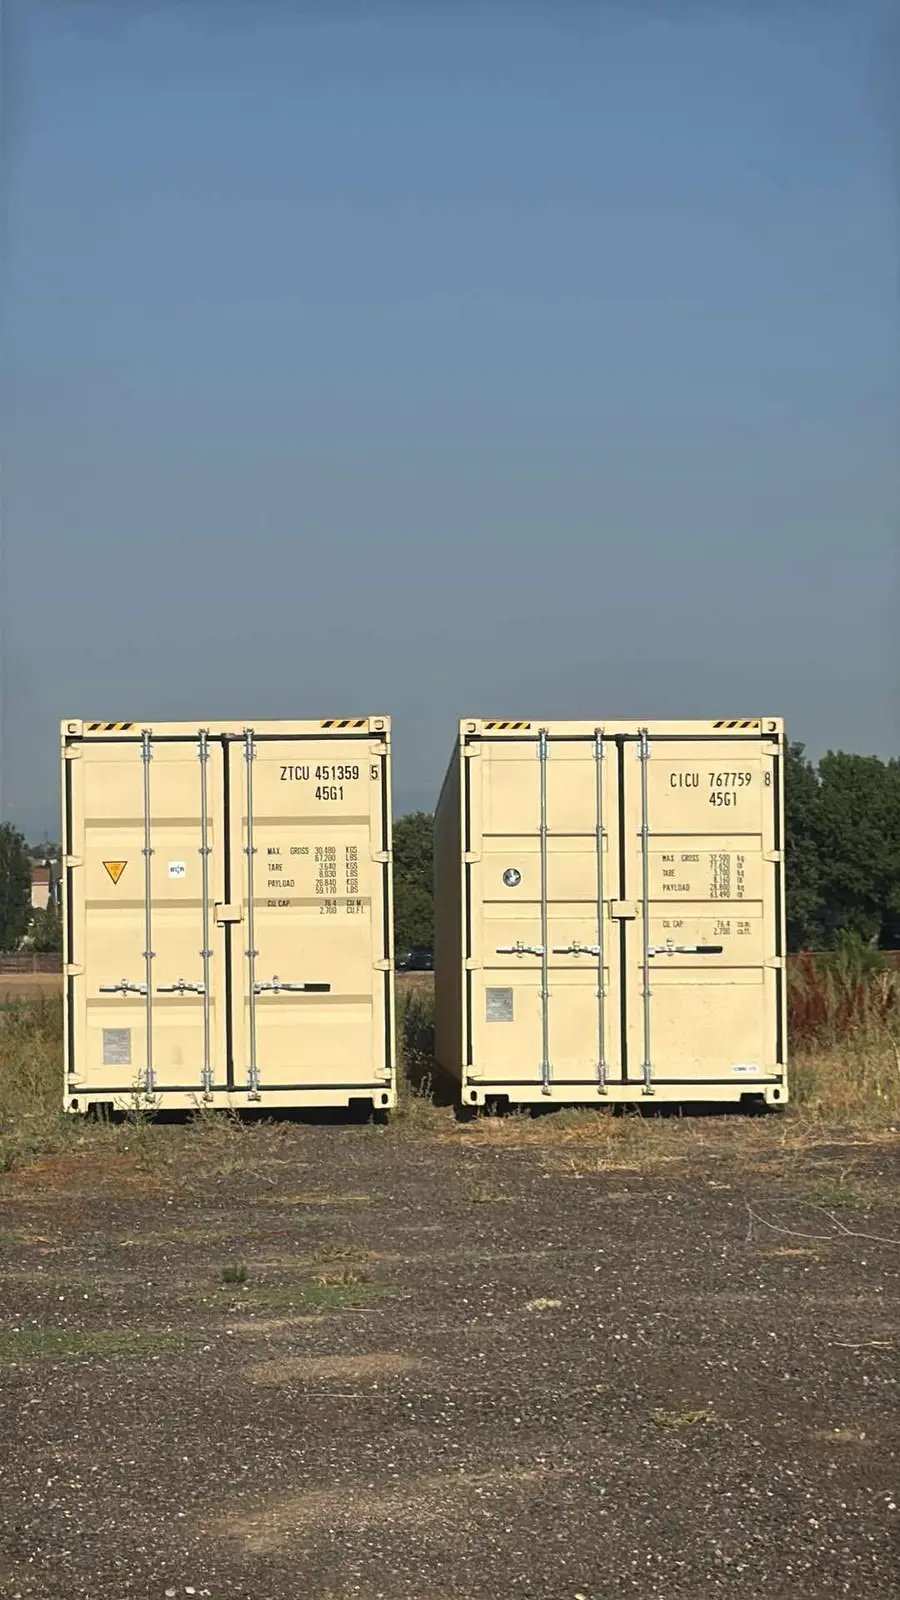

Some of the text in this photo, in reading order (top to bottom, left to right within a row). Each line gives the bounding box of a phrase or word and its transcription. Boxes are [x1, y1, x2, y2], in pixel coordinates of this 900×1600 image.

[280, 765, 378, 780] ZTCU 451359 5
[670, 772, 770, 787] CICU 767759 8
[315, 786, 344, 800] 45G1
[710, 792, 737, 806] 45G1
[290, 846, 310, 854] GROSS
